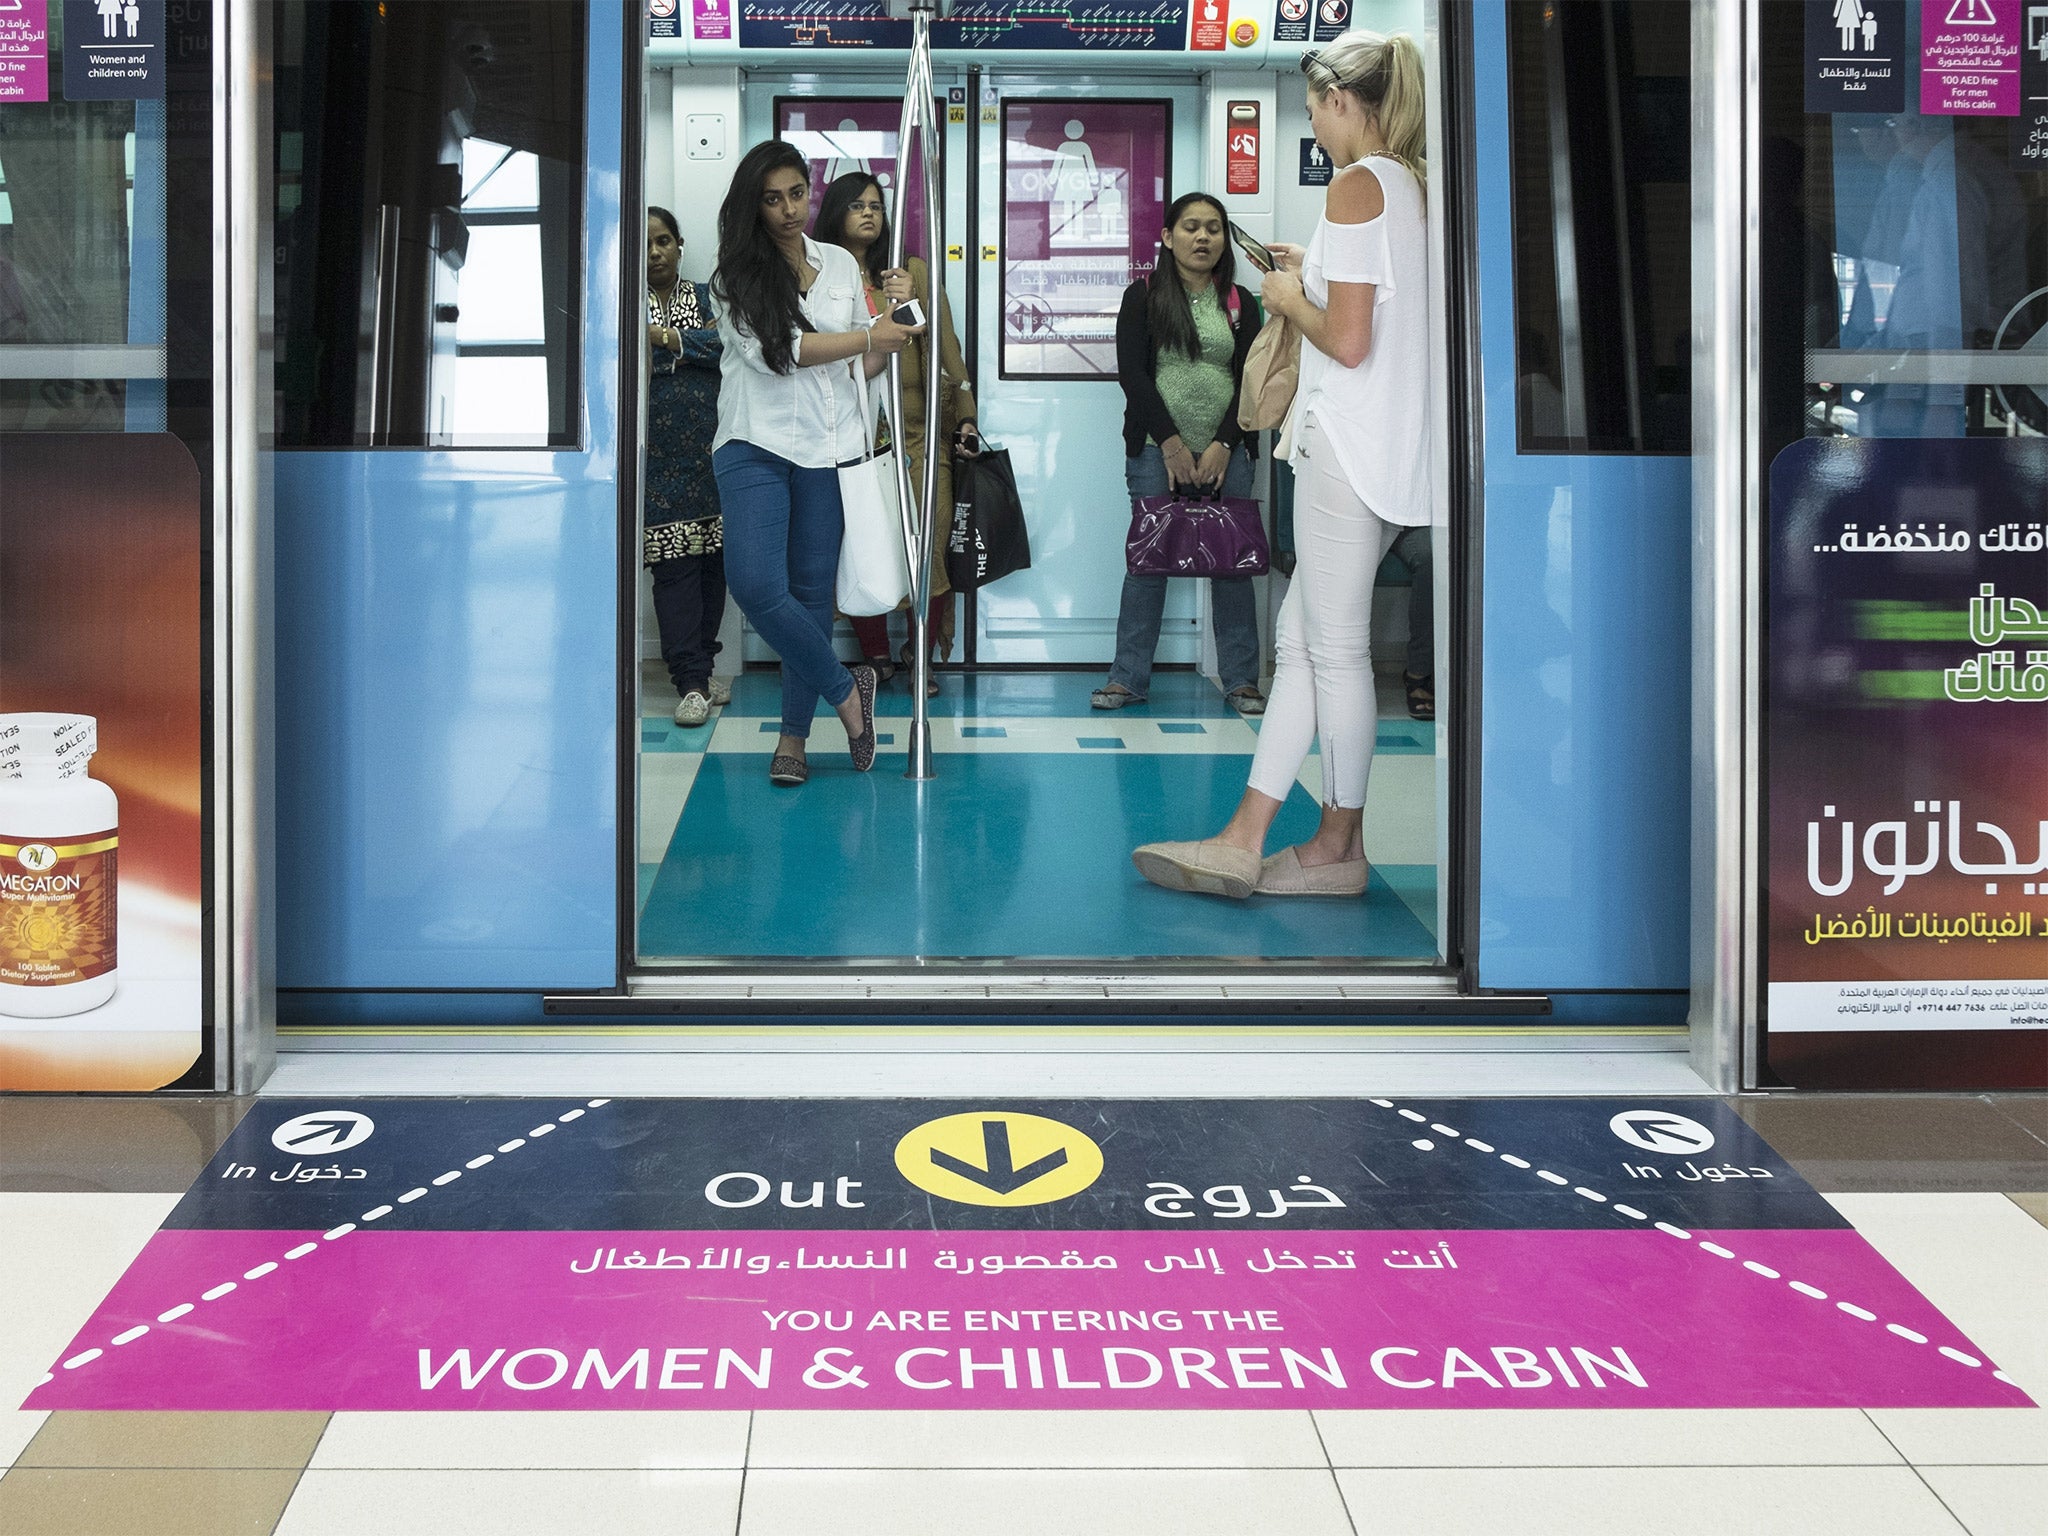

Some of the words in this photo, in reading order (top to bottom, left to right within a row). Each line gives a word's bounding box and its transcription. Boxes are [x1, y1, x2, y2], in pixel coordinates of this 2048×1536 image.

[18, 30, 44, 42] للرجال
[1936, 34, 1960, 43] درهم
[1964, 34, 1979, 42] 100
[1981, 34, 2004, 43] غرامة
[8, 43, 30, 52] هذه
[1926, 46, 1942, 56] في
[1944, 45, 1990, 55] المتواجدين
[1992, 46, 2018, 56] للرجال
[90, 55, 126, 64] Women
[128, 55, 146, 64] and
[1938, 58, 1980, 68] المقصورة
[1982, 58, 2002, 66] هذه
[8, 62, 26, 71] fine
[88, 68, 126, 78] children
[128, 68, 148, 80] only
[1819, 68, 1860, 80] والأطفال
[1862, 68, 1891, 78] للنساء
[1942, 76, 1958, 84] 100
[1960, 76, 1979, 84] AED
[1982, 76, 1998, 84] fine
[0, 86, 24, 95] cabin
[1843, 81, 1867, 90] فقط
[1952, 88, 1966, 97] For
[1944, 100, 1952, 108] In
[1954, 100, 1970, 108] this
[1972, 100, 1996, 109] cabin
[976, 553, 987, 578] THE
[55, 730, 87, 757] SEALED
[1, 890, 24, 901] Super
[26, 892, 76, 902] Multivitamin
[1804, 906, 1891, 945] الأفضل
[1898, 912, 2032, 944] الفيتامينات
[18, 963, 32, 972] 100
[34, 963, 60, 972] Tablets
[1, 968, 29, 981] Dietary
[31, 970, 76, 982] Supplement
[1916, 1004, 1943, 1012] +9714
[1946, 1004, 1962, 1012] 447
[1965, 1004, 1985, 1012] 7636
[222, 1162, 256, 1179] In
[270, 1162, 368, 1183] دخول
[1622, 1162, 1662, 1179] In
[1676, 1162, 1774, 1183] دخول
[704, 1172, 866, 1209] Out
[1144, 1176, 1346, 1218] خروج
[1248, 1248, 1356, 1273] تدخل
[1382, 1241, 1458, 1270] أنت
[934, 1248, 1117, 1275] مقصورة
[1145, 1246, 1226, 1276] إلى
[762, 1310, 854, 1332] YOU
[866, 1310, 950, 1332] ARE
[964, 1310, 1182, 1332] ENTERING
[1194, 1310, 1284, 1332] THE
[417, 1347, 772, 1390] WOMEN
[801, 1347, 870, 1390] &
[894, 1347, 1348, 1390] CHILDREN
[1370, 1346, 1648, 1390] CABIN
